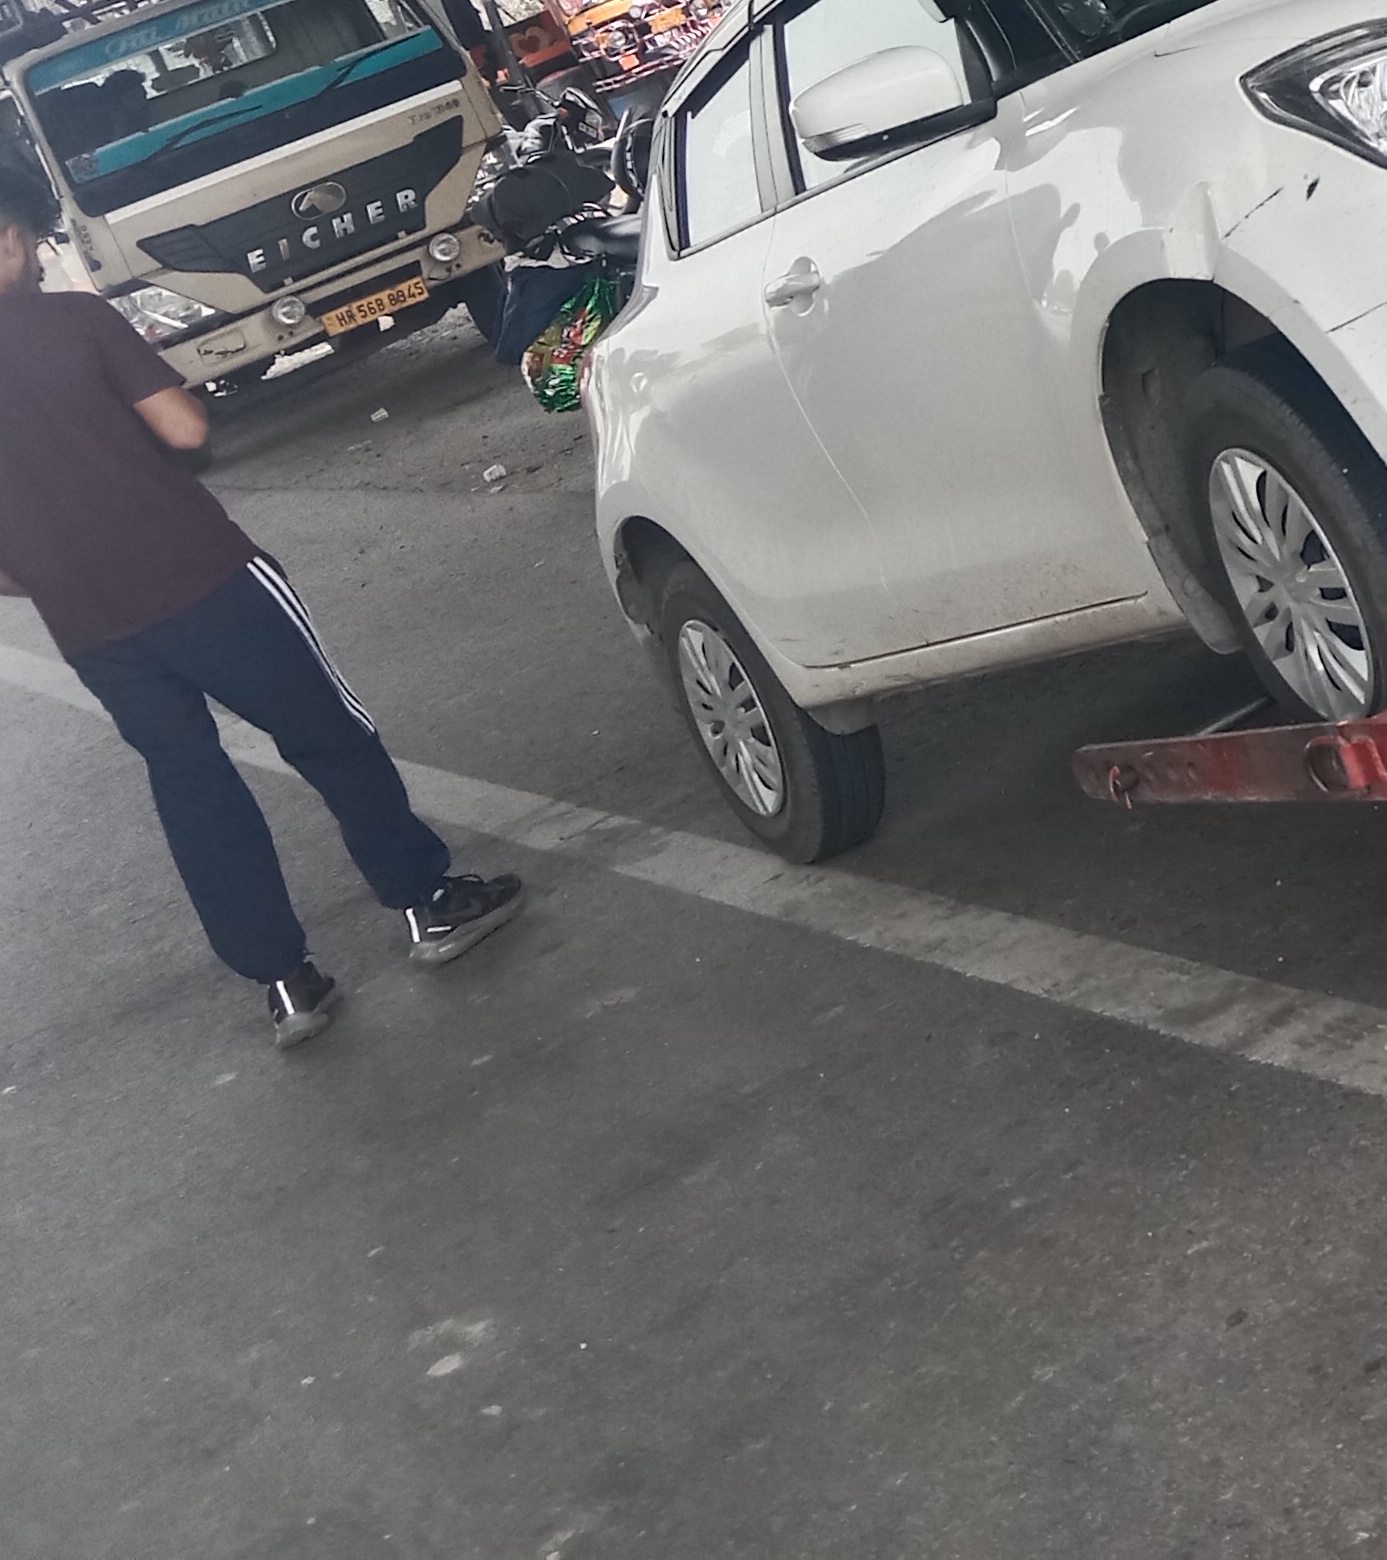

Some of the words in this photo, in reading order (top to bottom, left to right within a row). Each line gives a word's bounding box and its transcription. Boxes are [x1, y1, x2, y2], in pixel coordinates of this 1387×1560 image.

[247, 189, 418, 273] EICHER
[335, 306, 358, 328] HR
[357, 298, 386, 320] 56B
